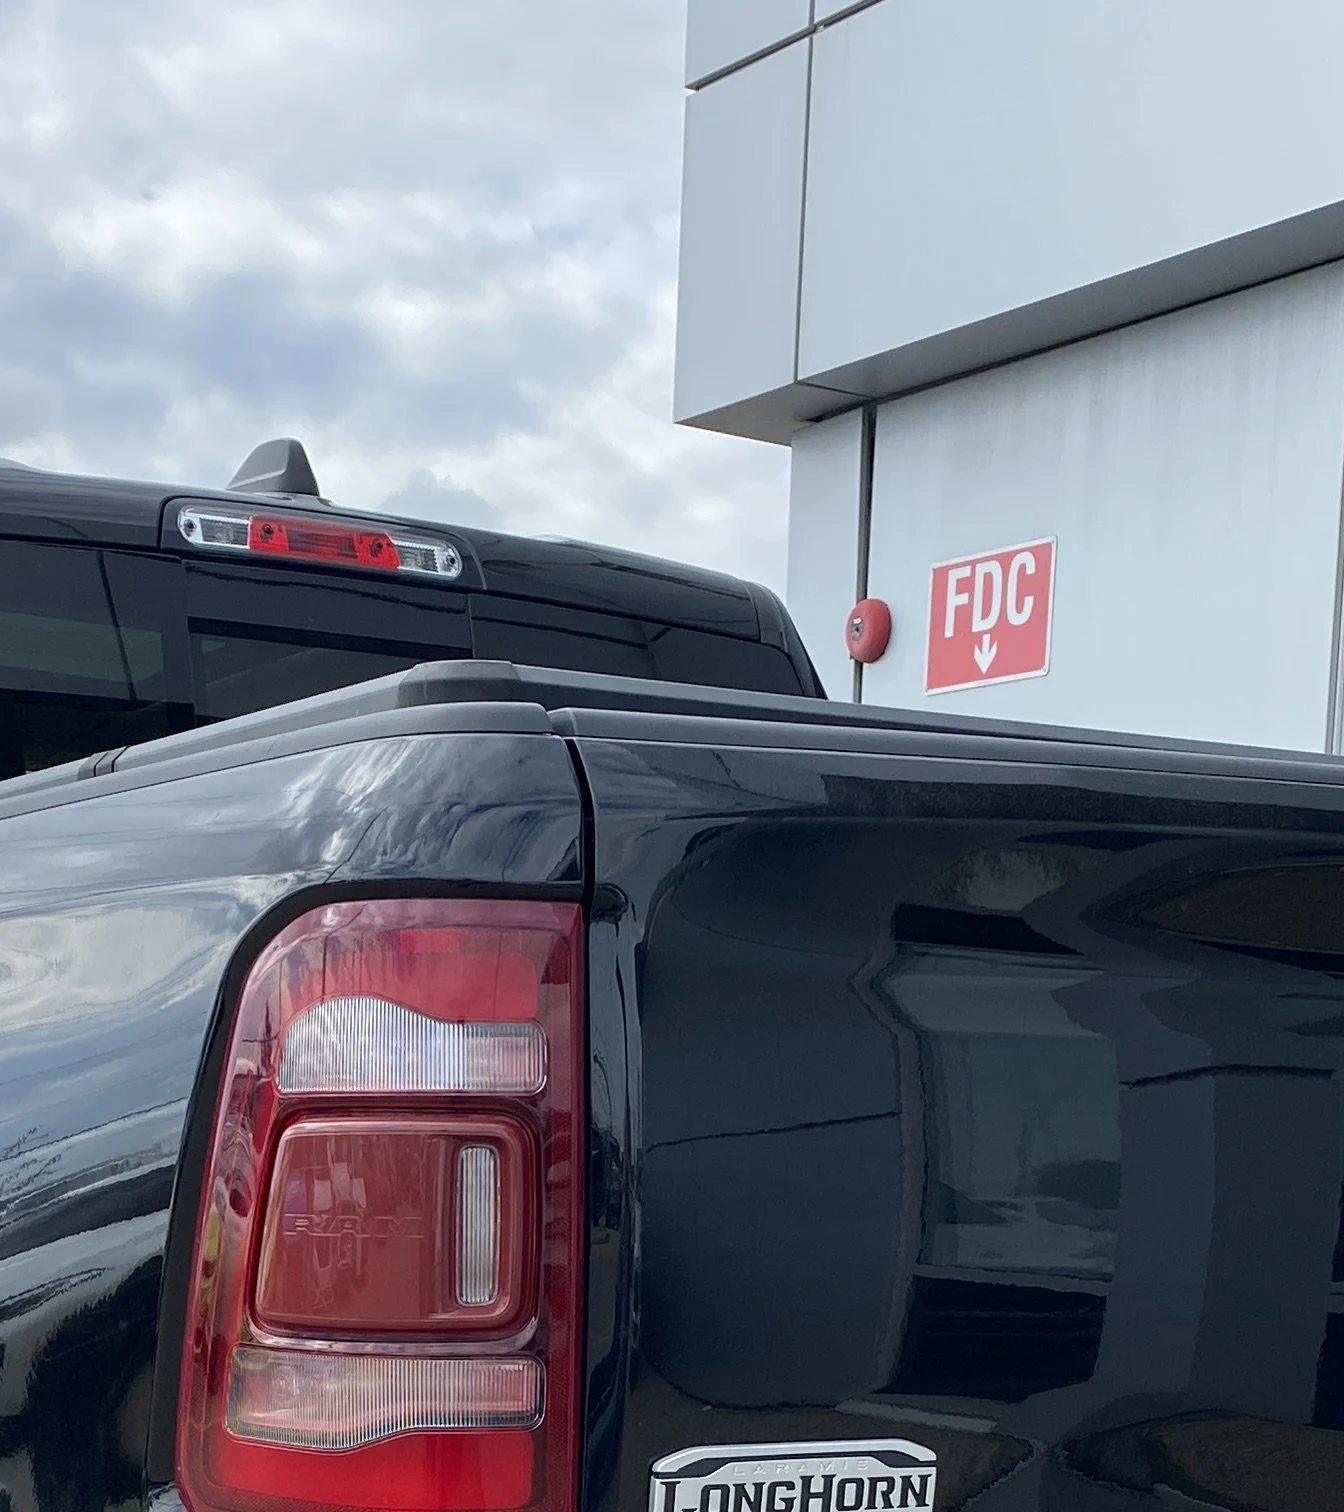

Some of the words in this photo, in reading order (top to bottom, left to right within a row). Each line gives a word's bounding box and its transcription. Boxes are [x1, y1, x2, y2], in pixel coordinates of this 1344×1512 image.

[943, 551, 1036, 639] FDC
[284, 1213, 425, 1238] RAM
[732, 1459, 871, 1477] LARAMIE
